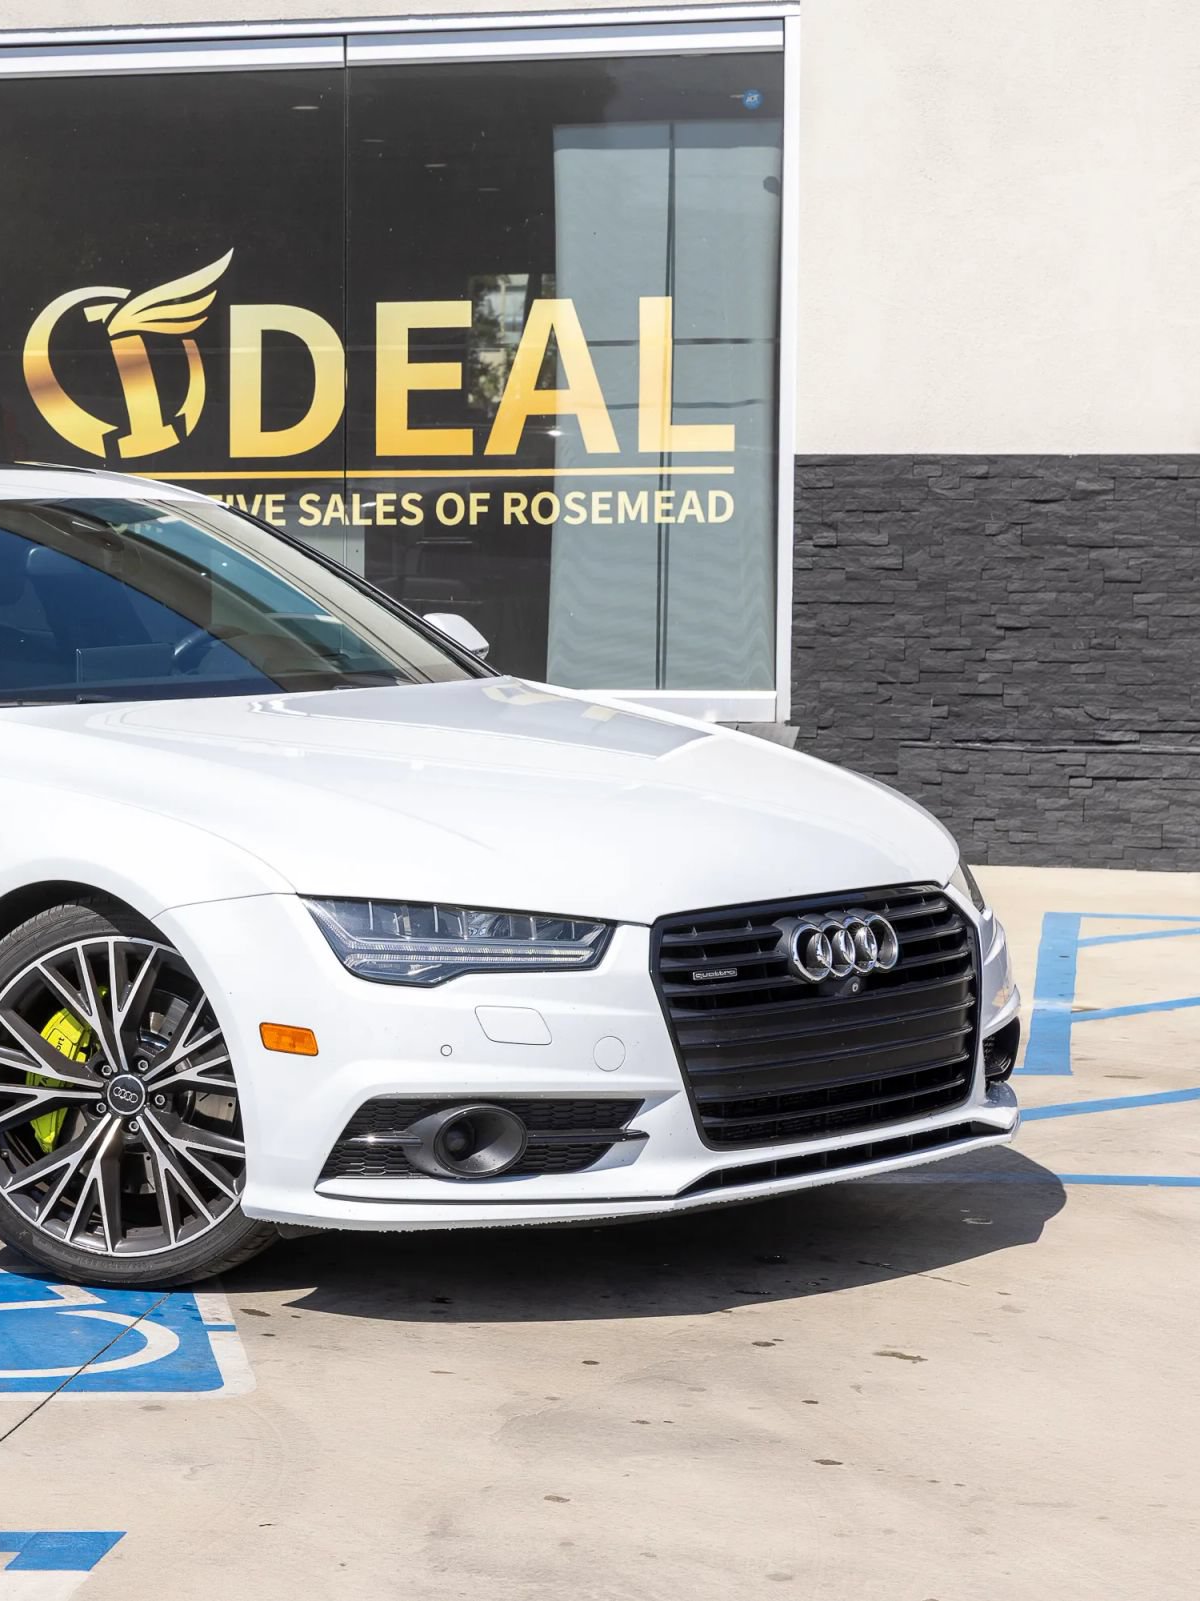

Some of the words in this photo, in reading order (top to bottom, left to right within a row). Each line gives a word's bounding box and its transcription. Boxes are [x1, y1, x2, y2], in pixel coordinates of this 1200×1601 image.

[298, 492, 423, 527] SALES
[435, 492, 490, 526] OF
[502, 490, 735, 526] ROSEMEAD
[694, 969, 736, 979] quattro
